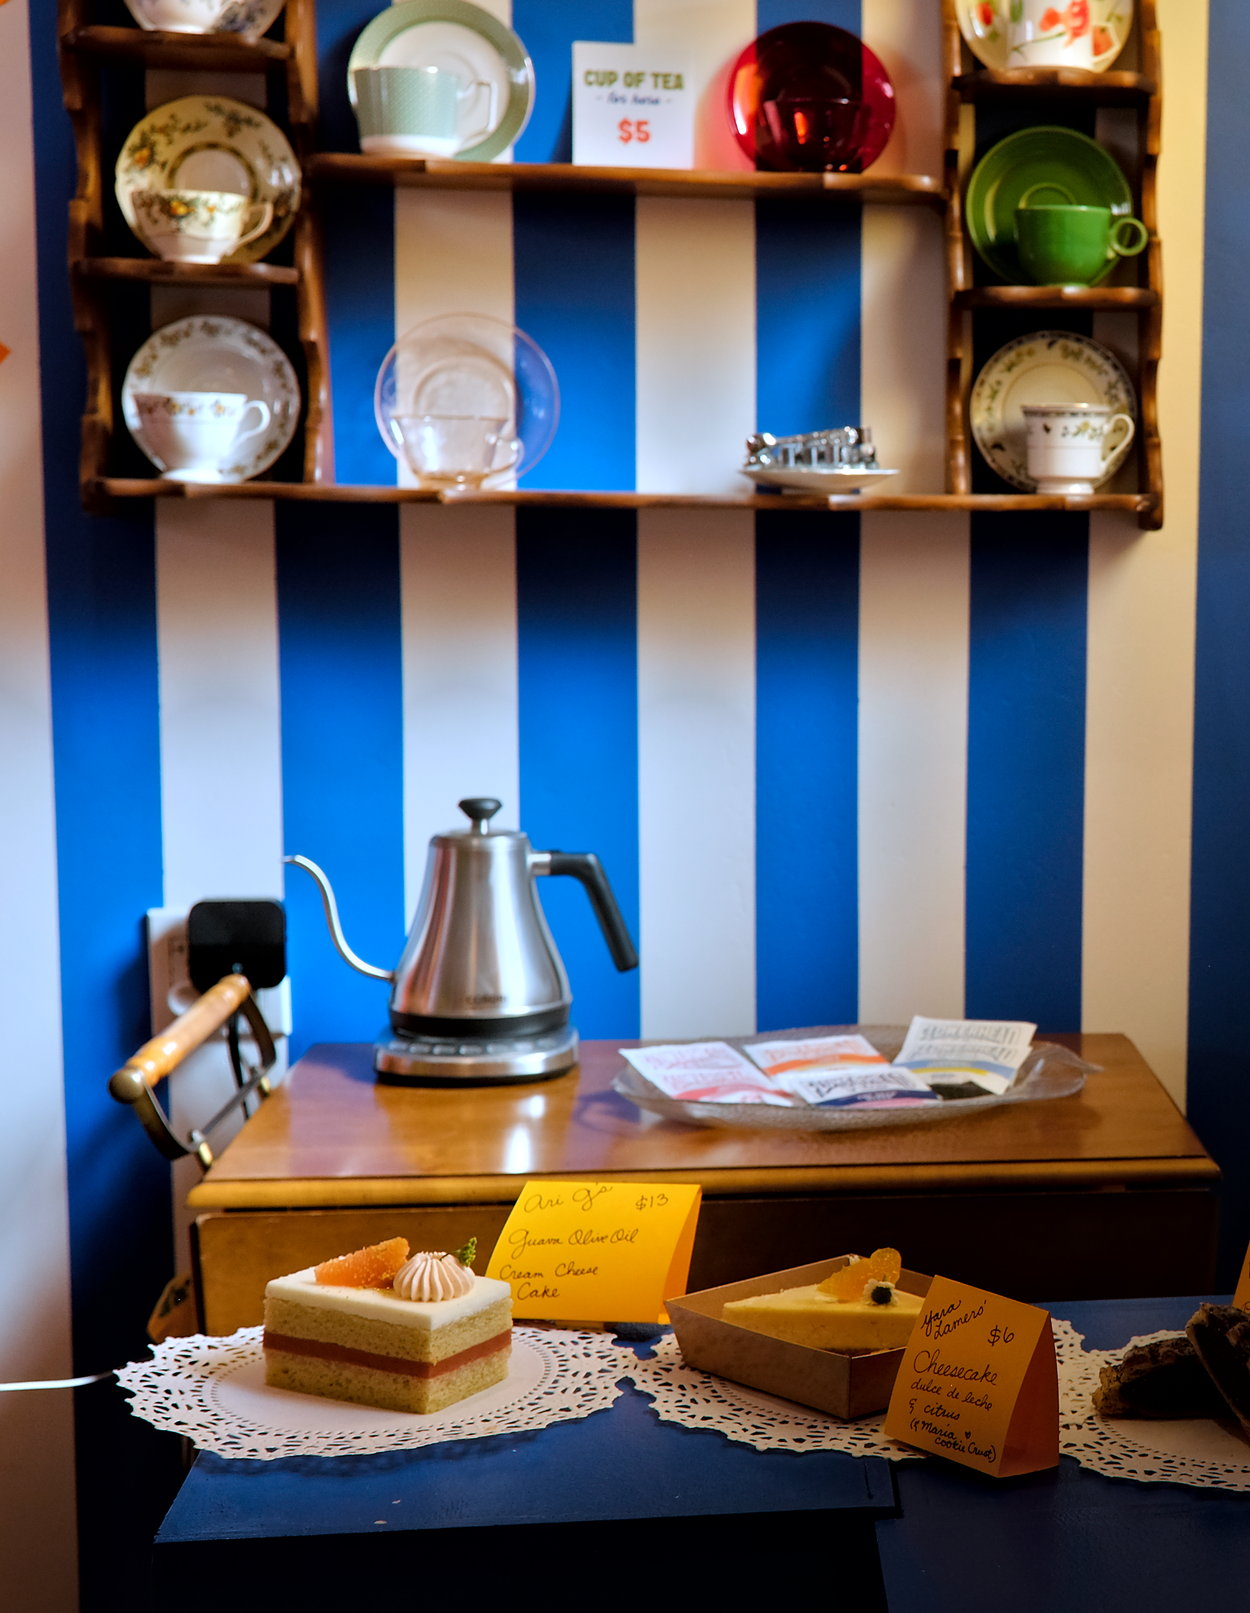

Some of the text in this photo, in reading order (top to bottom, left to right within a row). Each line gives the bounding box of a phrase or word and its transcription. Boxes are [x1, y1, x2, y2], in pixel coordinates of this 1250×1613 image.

[584, 70, 684, 89] CUP OF TEA
[618, 117, 651, 144] $5
[636, 1193, 669, 1210] $13
[499, 1261, 598, 1280] Cream Cheese
[517, 1282, 560, 1300] Cake
[988, 1325, 1014, 1346] $6
[914, 1349, 998, 1385] Cheesecake
[911, 1378, 993, 1411] dulce de leche
[924, 1402, 960, 1420] citrus
[935, 1437, 965, 1453] cookie
